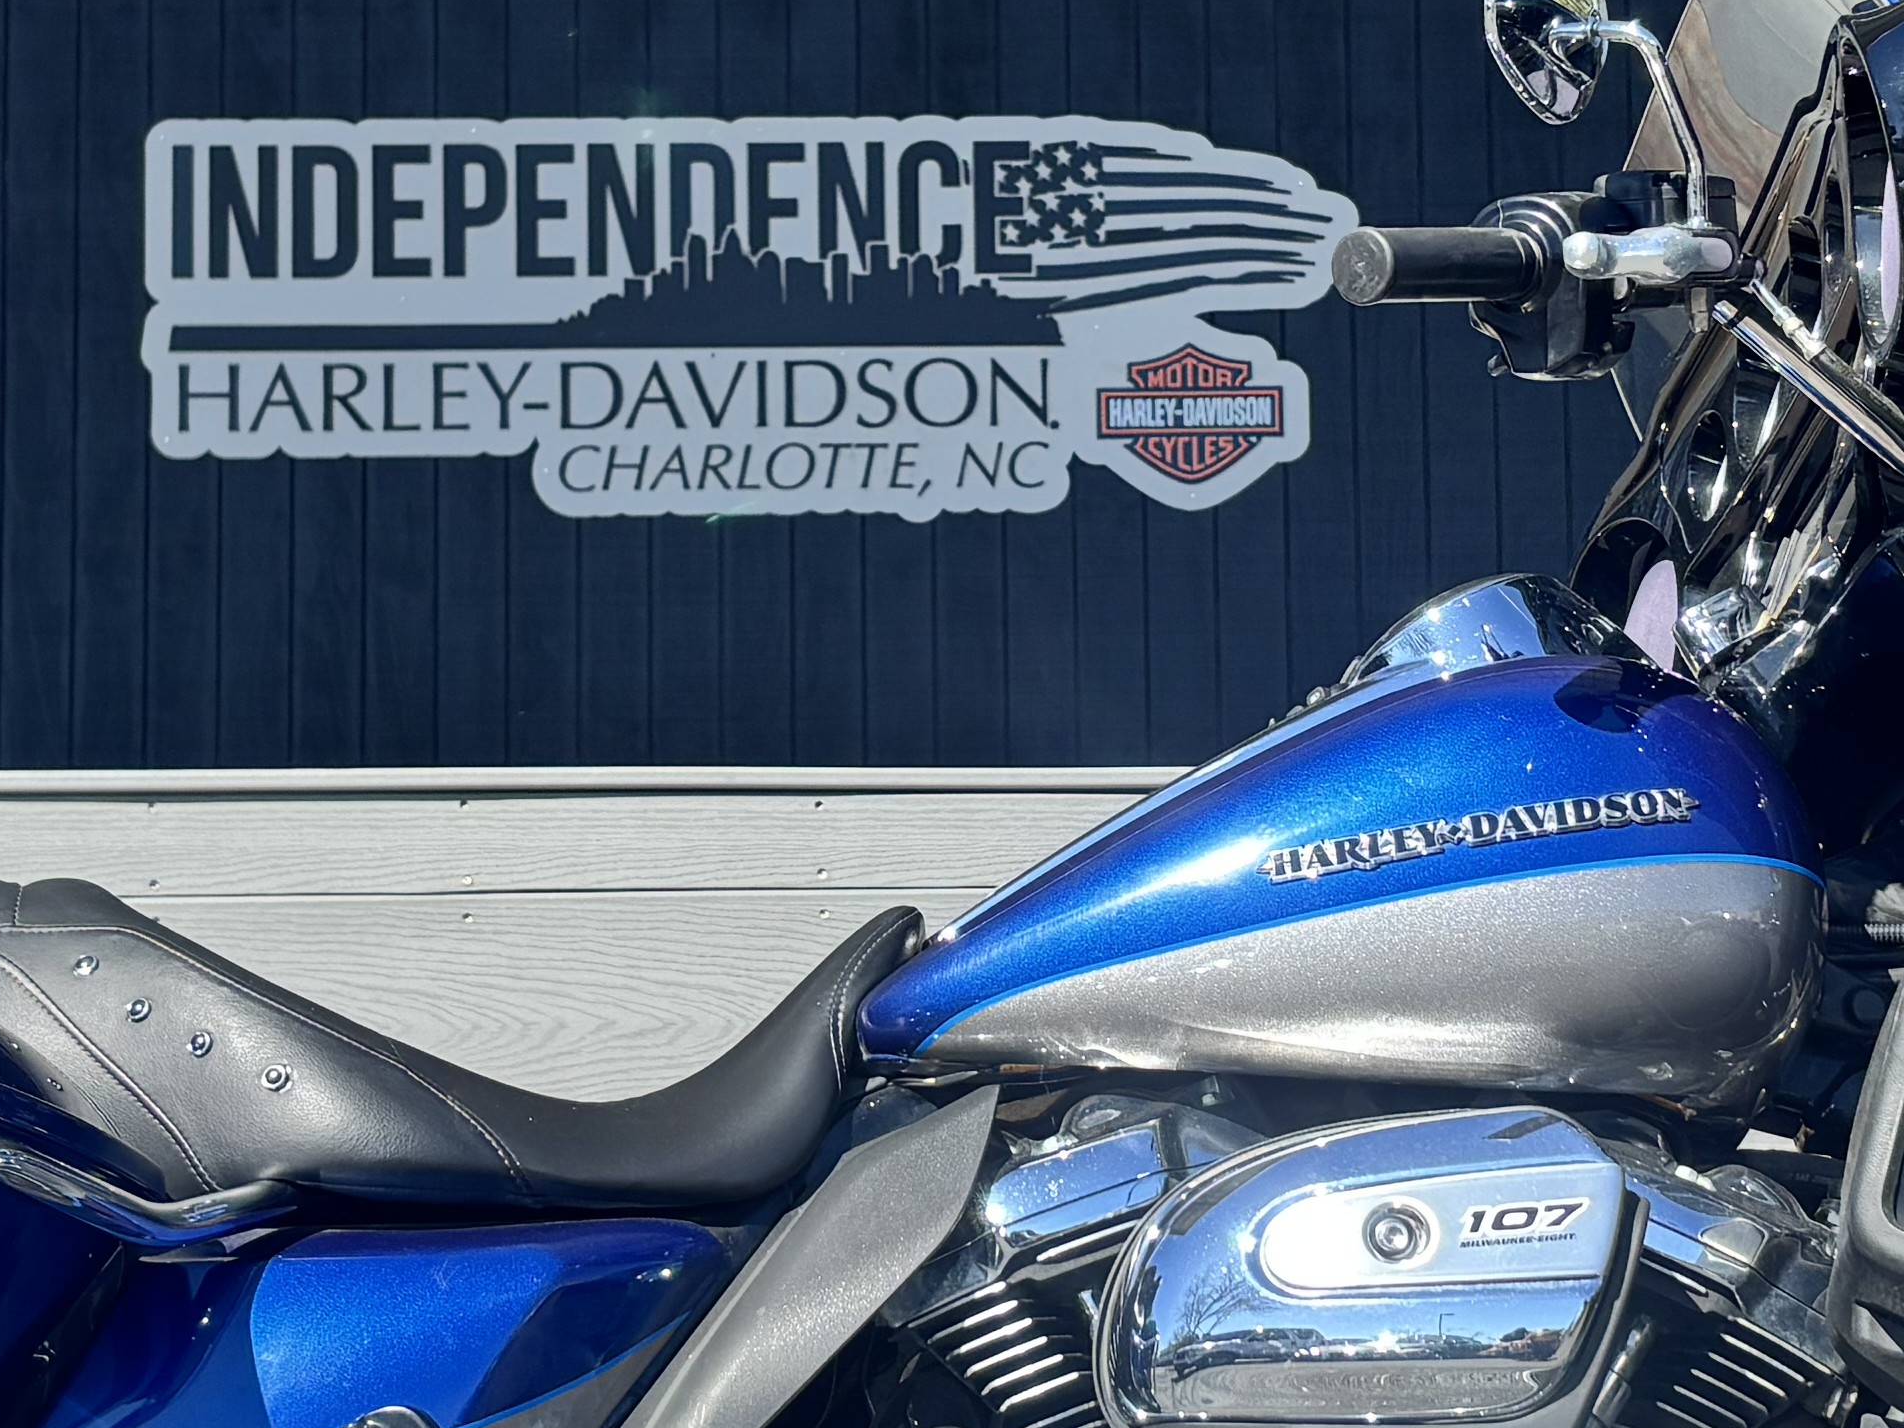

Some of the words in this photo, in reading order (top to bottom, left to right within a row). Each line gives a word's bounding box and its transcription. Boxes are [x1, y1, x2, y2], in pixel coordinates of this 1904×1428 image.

[171, 140, 1032, 279] INDEPENDENCE
[1147, 358, 1233, 389] MOTOR
[1108, 396, 1273, 428] HARLEY-DAVIDSON
[558, 441, 932, 497] CHARLOTTE,
[955, 440, 1050, 489] NC
[1148, 436, 1234, 472] CYCLES
[1466, 1200, 1586, 1235] 107
